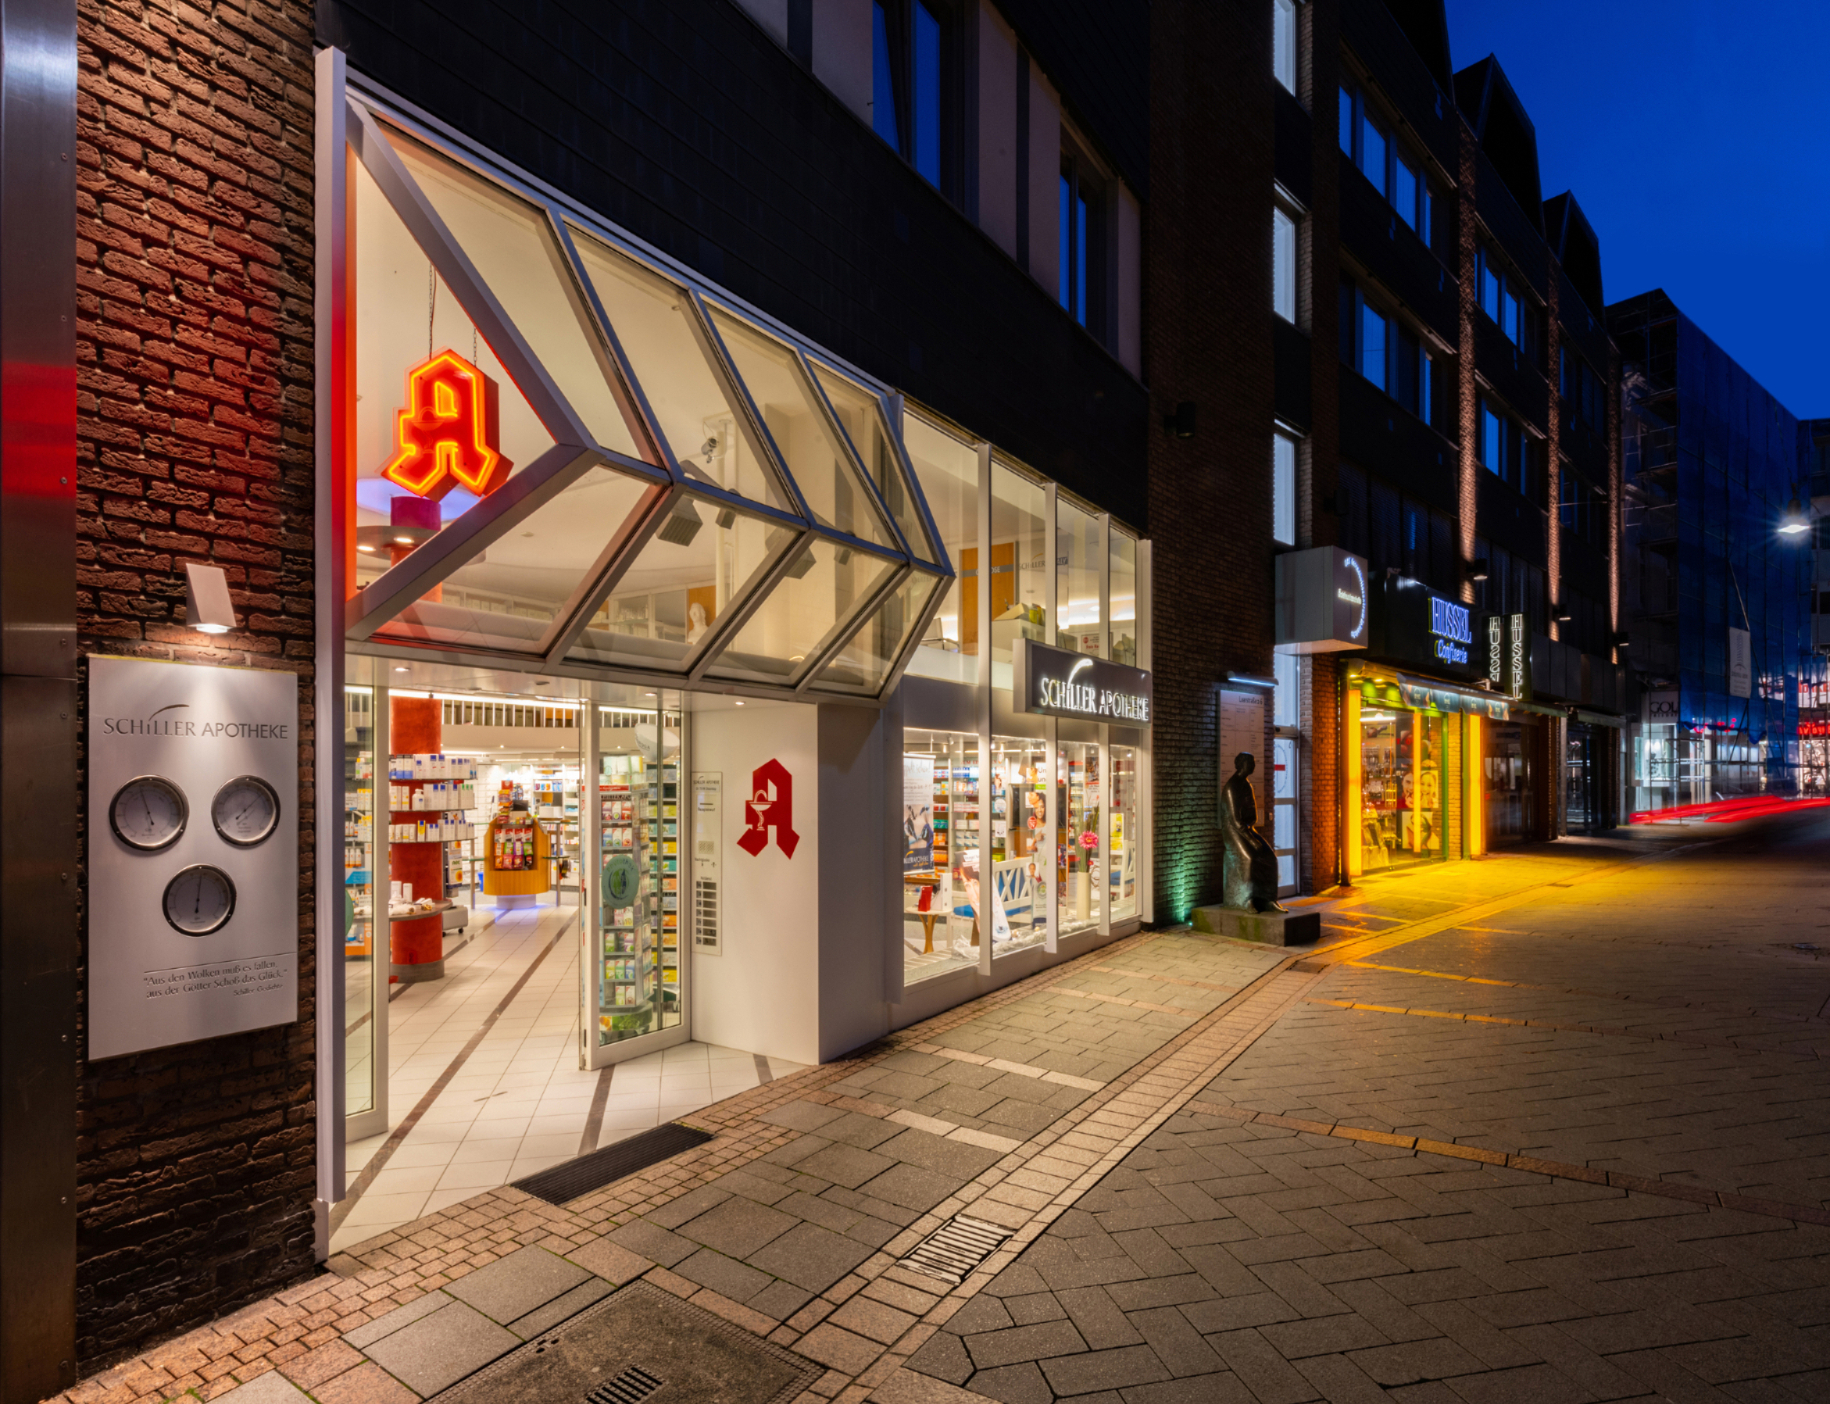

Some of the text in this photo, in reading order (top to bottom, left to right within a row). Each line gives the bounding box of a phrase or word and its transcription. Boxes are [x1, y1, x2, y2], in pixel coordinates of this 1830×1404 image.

[1431, 597, 1472, 644] HUSSEL
[1511, 613, 1523, 700] HUSSEL
[1099, 689, 1149, 721] APOTHEKE
[201, 722, 288, 740] APOTHEKE
[146, 989, 163, 998] aus
[165, 985, 180, 995] der
[183, 982, 212, 993] Götter
[214, 976, 241, 988] Schoß
[242, 974, 256, 984] das
[168, 973, 185, 983] den
[188, 969, 220, 980] Wolken
[222, 965, 241, 975] muß
